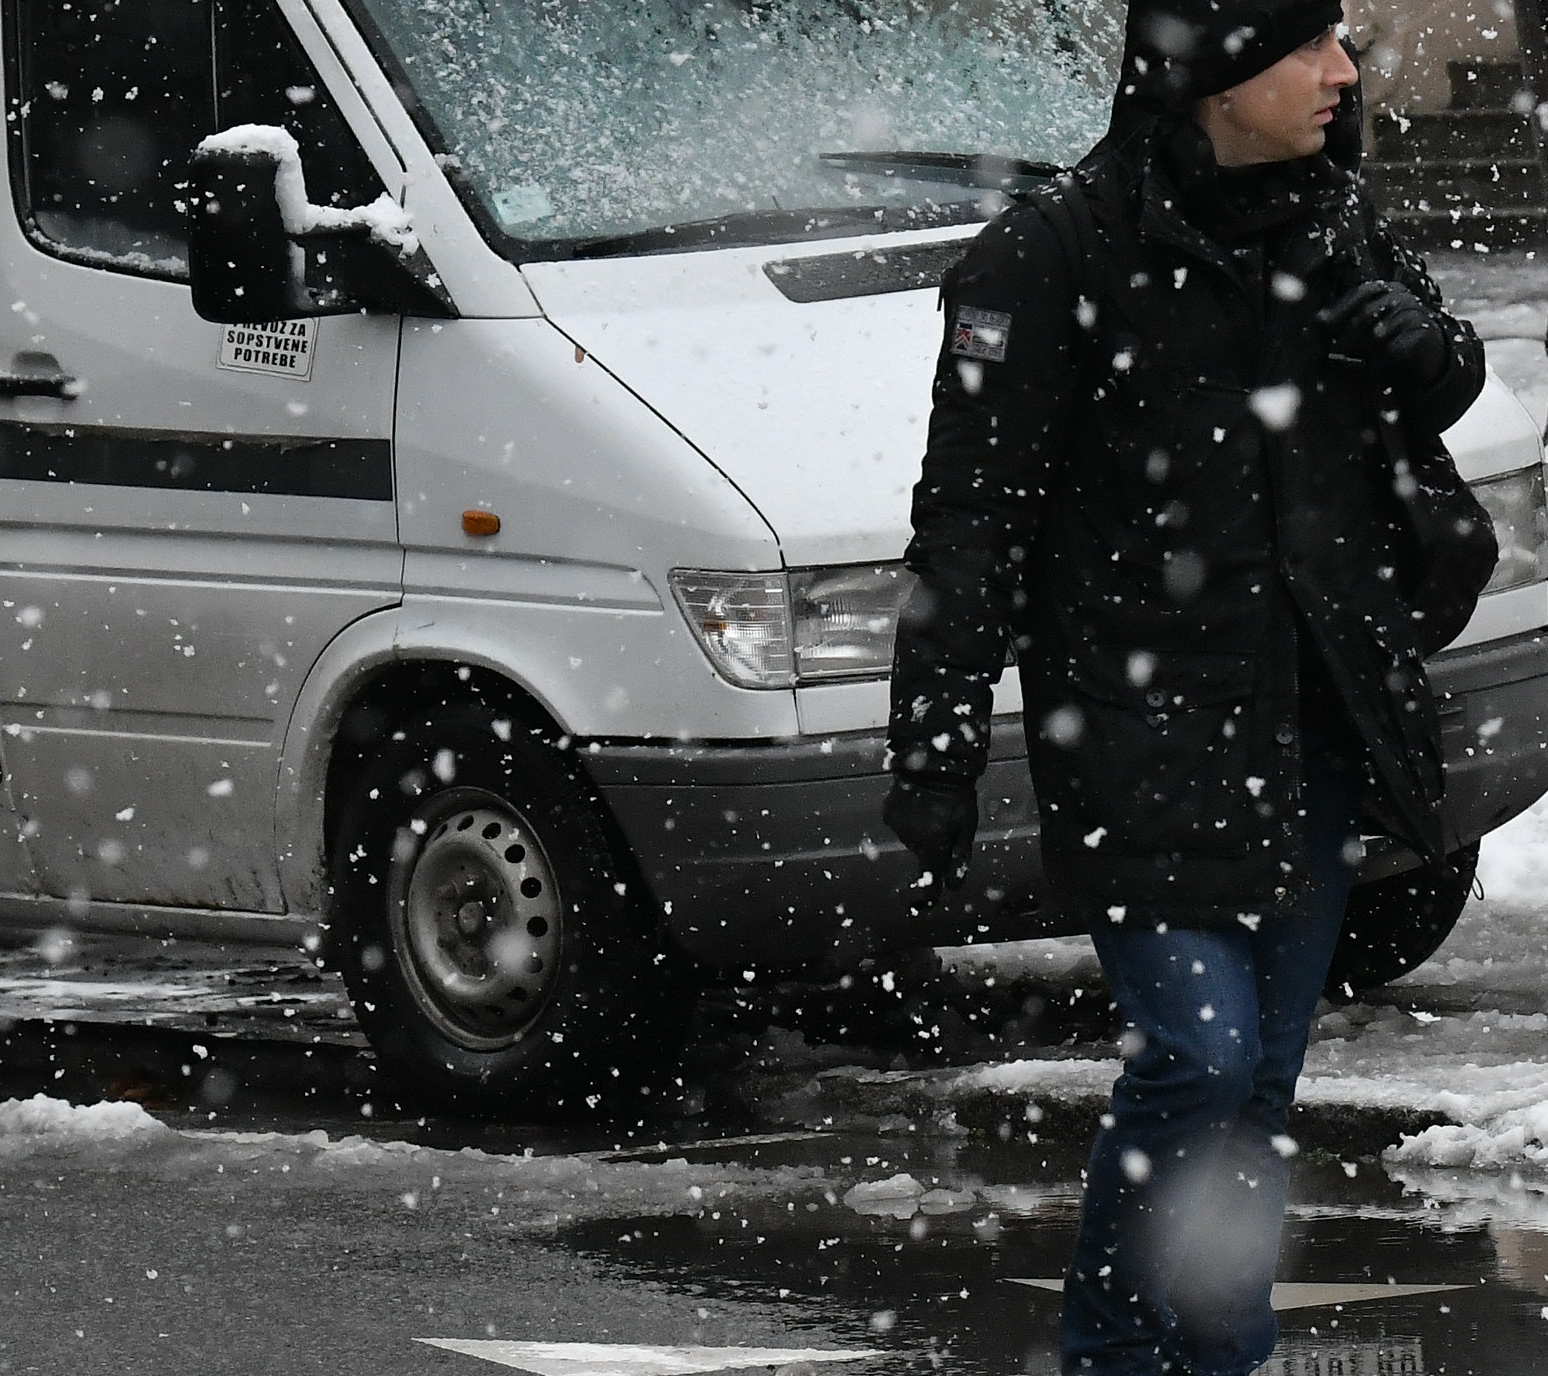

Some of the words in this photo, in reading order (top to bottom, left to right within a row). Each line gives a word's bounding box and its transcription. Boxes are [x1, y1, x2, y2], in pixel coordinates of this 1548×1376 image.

[232, 321, 287, 334] EVOZ
[289, 322, 307, 337] ZA
[227, 330, 309, 354] SOPSTVENE
[233, 347, 296, 368] POTREBE
